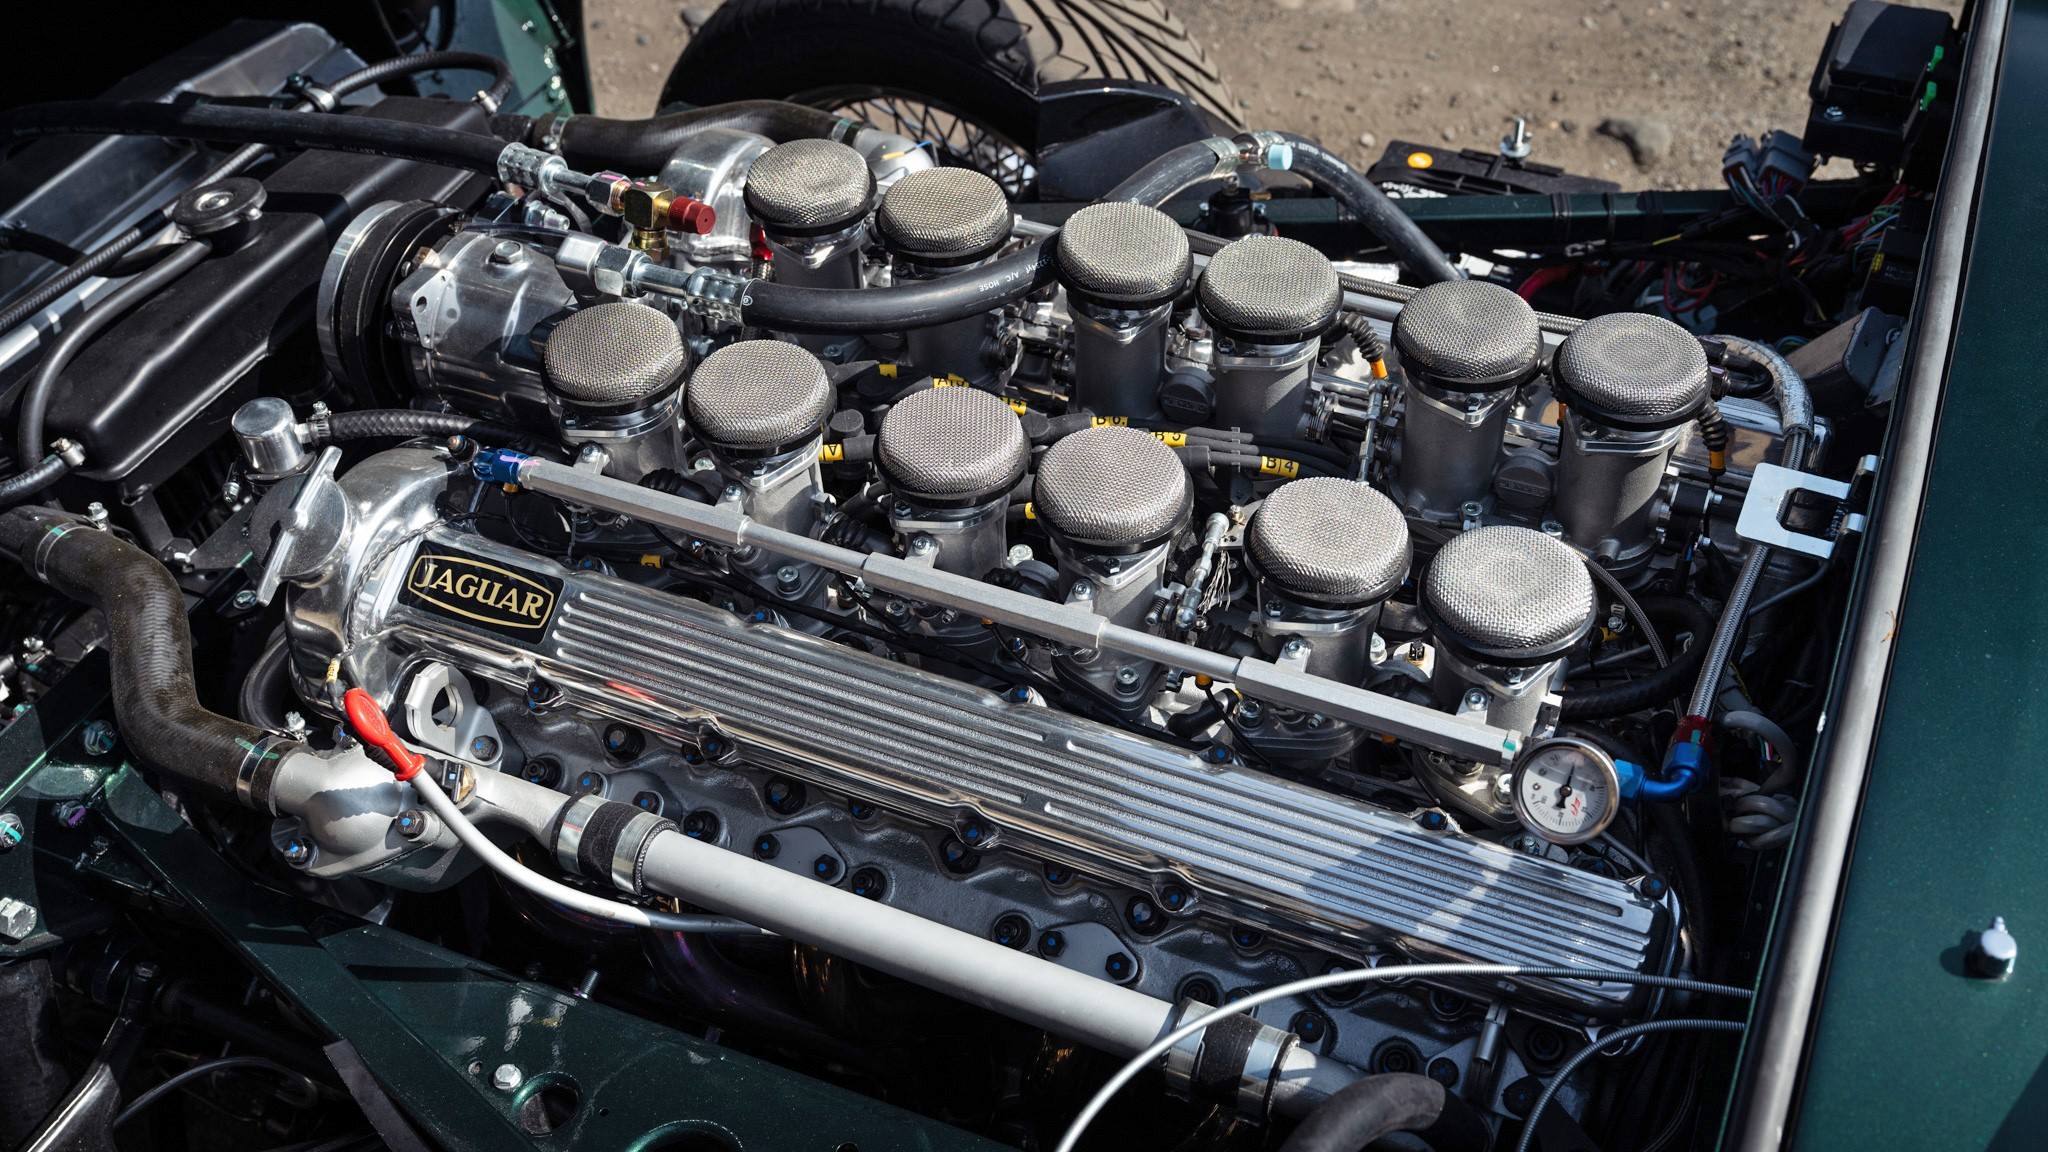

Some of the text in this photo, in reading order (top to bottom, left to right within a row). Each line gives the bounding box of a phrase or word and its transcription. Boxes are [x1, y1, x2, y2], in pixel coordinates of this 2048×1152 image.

[1005, 271, 1019, 283] A/C
[978, 279, 1000, 293] HOSE
[414, 563, 544, 619] JAGUAR
